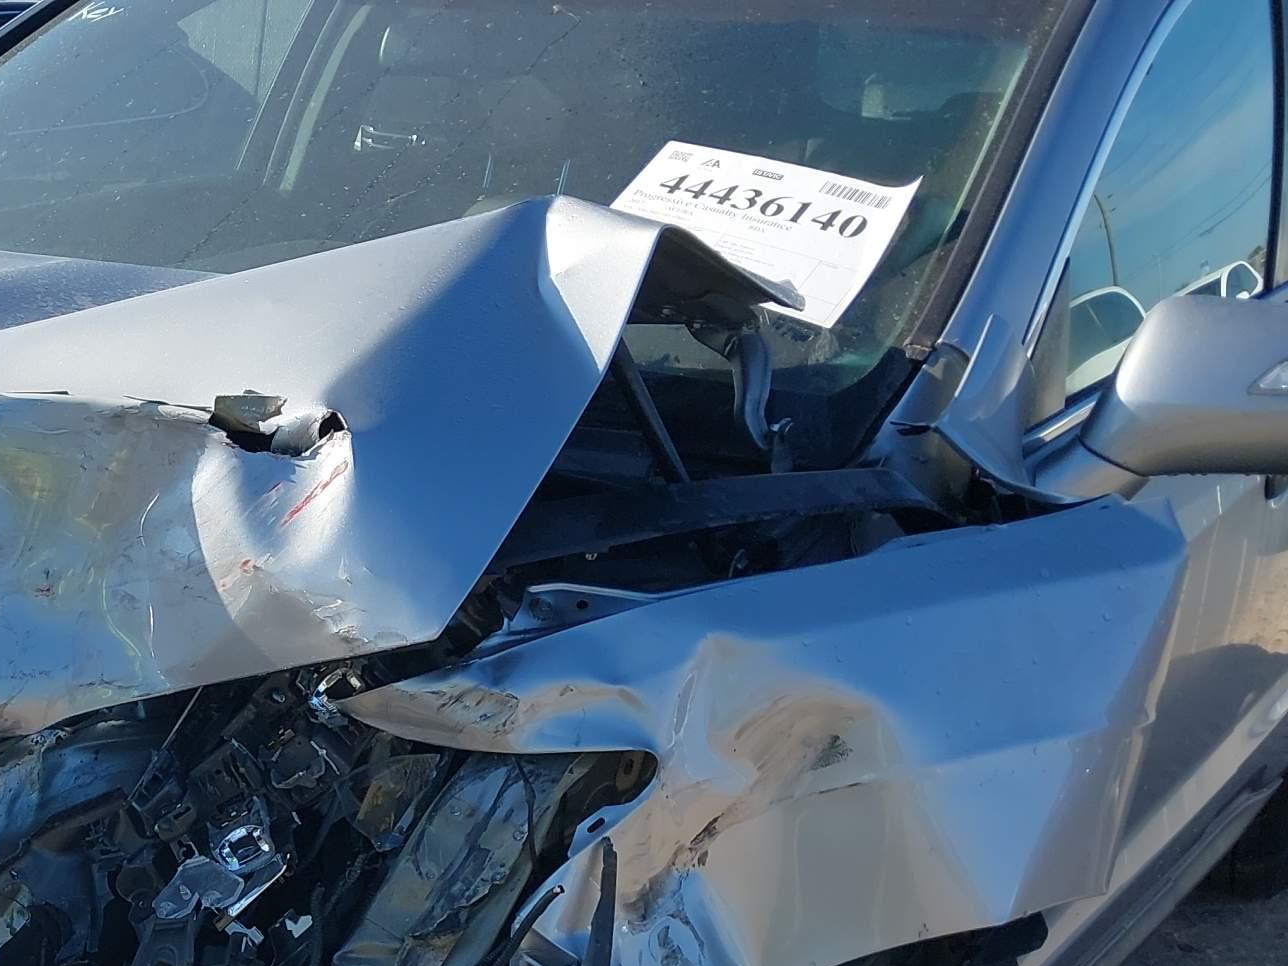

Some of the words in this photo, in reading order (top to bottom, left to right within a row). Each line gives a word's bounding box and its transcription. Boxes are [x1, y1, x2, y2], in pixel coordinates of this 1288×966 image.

[633, 189, 693, 209] Progressive
[694, 201, 736, 218] Casualty
[741, 213, 793, 231] Insurance
[659, 174, 867, 238] 44436140
